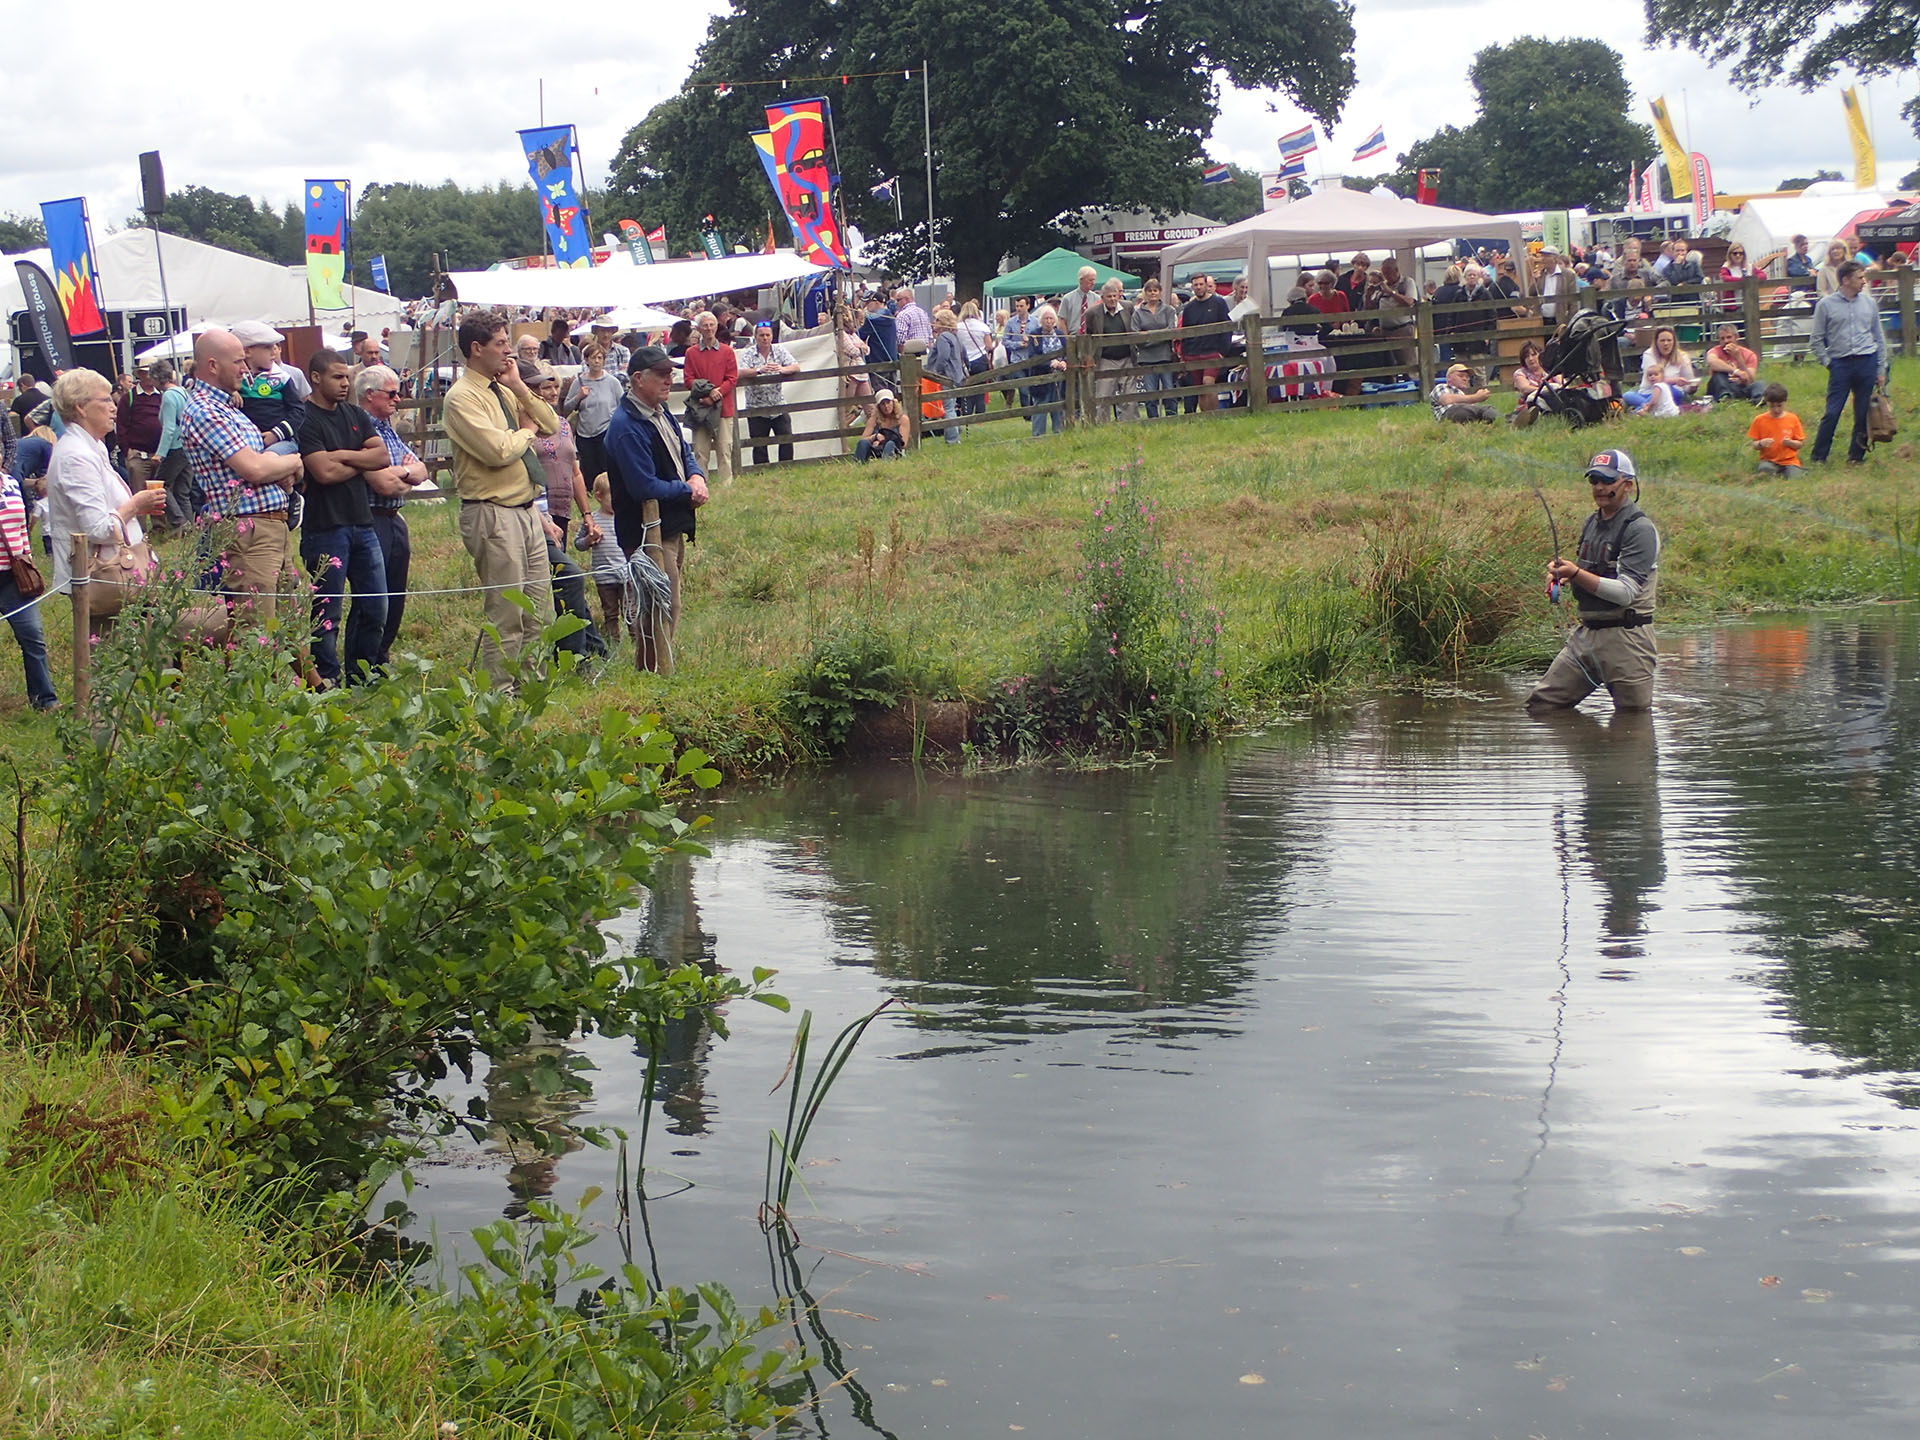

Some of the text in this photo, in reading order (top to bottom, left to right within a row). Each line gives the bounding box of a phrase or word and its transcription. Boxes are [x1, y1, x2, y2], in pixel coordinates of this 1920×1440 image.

[1125, 227, 1218, 241] FRESHLY GROUND CO
